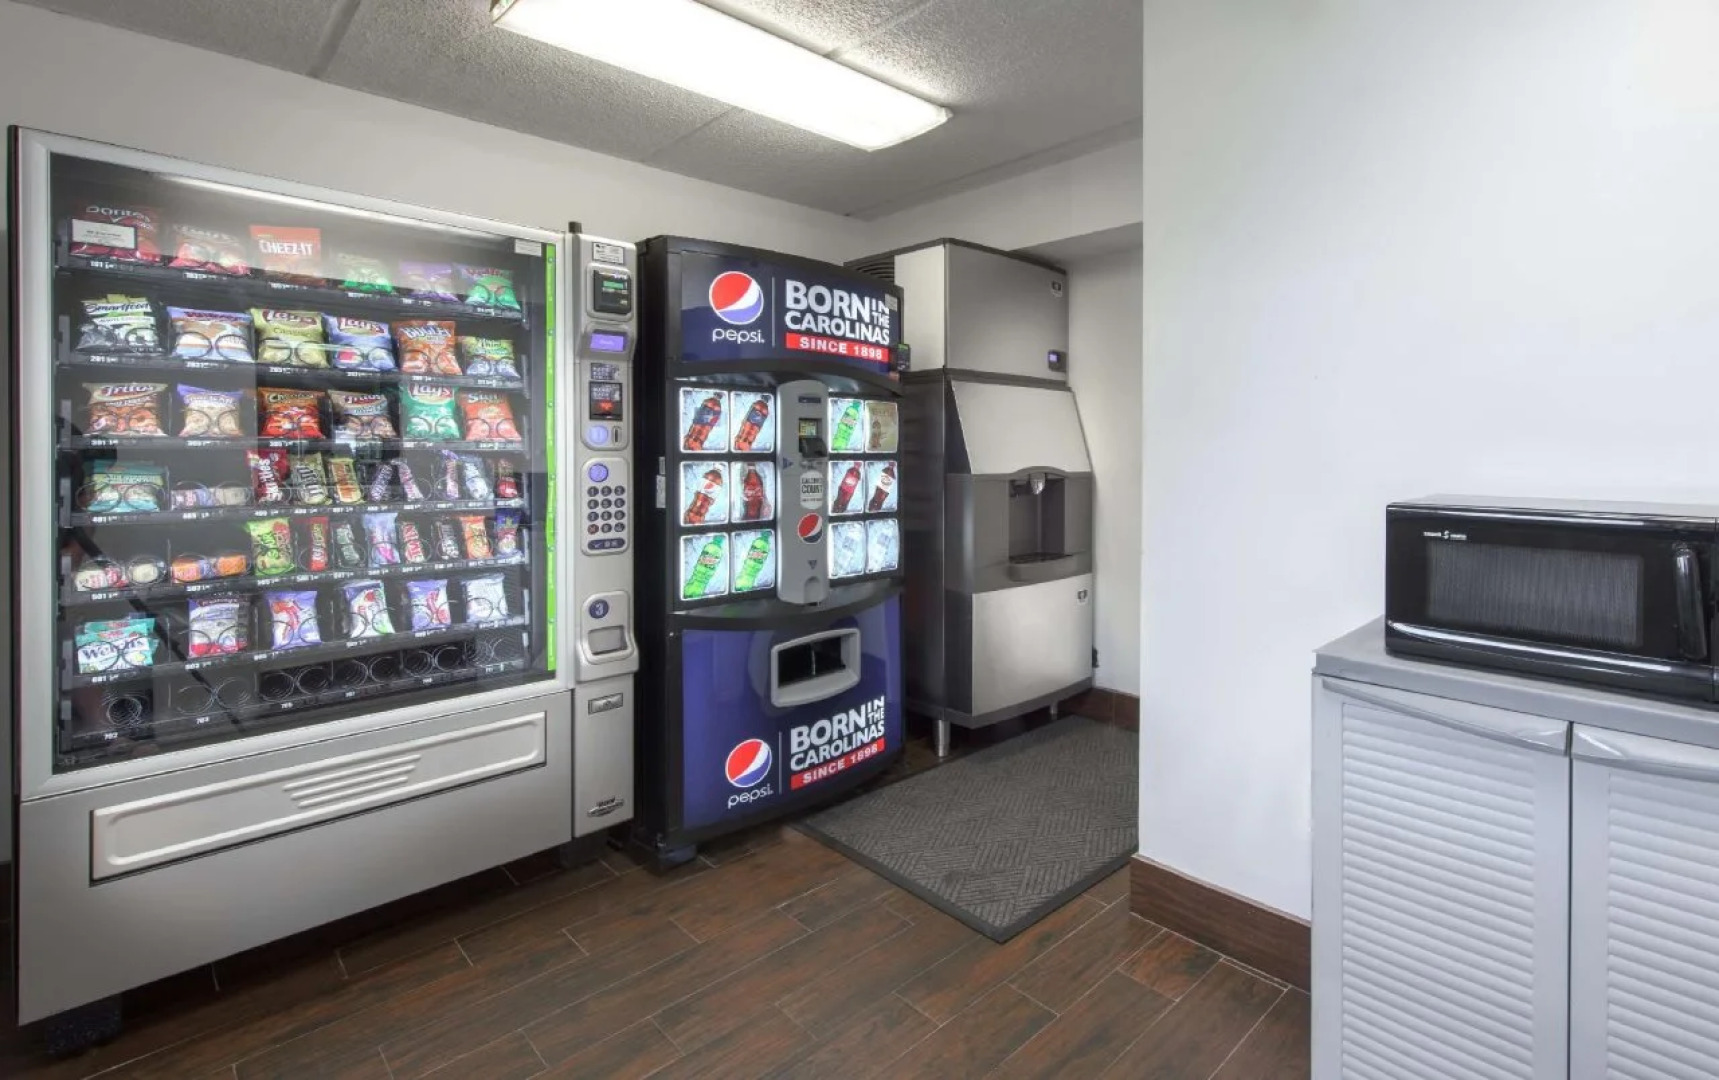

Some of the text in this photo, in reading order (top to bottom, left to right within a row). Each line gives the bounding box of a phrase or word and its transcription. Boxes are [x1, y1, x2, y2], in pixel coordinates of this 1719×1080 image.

[785, 279, 890, 323] BORN IN
[784, 311, 890, 345] CAROLINAS
[872, 312, 890, 329] THE
[712, 328, 763, 344] pepsi
[800, 336, 882, 360] SINCE 1898
[790, 696, 885, 754] BORN IN
[868, 707, 885, 725] THE
[790, 720, 885, 772] CAROLINAS
[803, 743, 878, 785] SINCE 1898
[727, 783, 774, 809] pepsi
